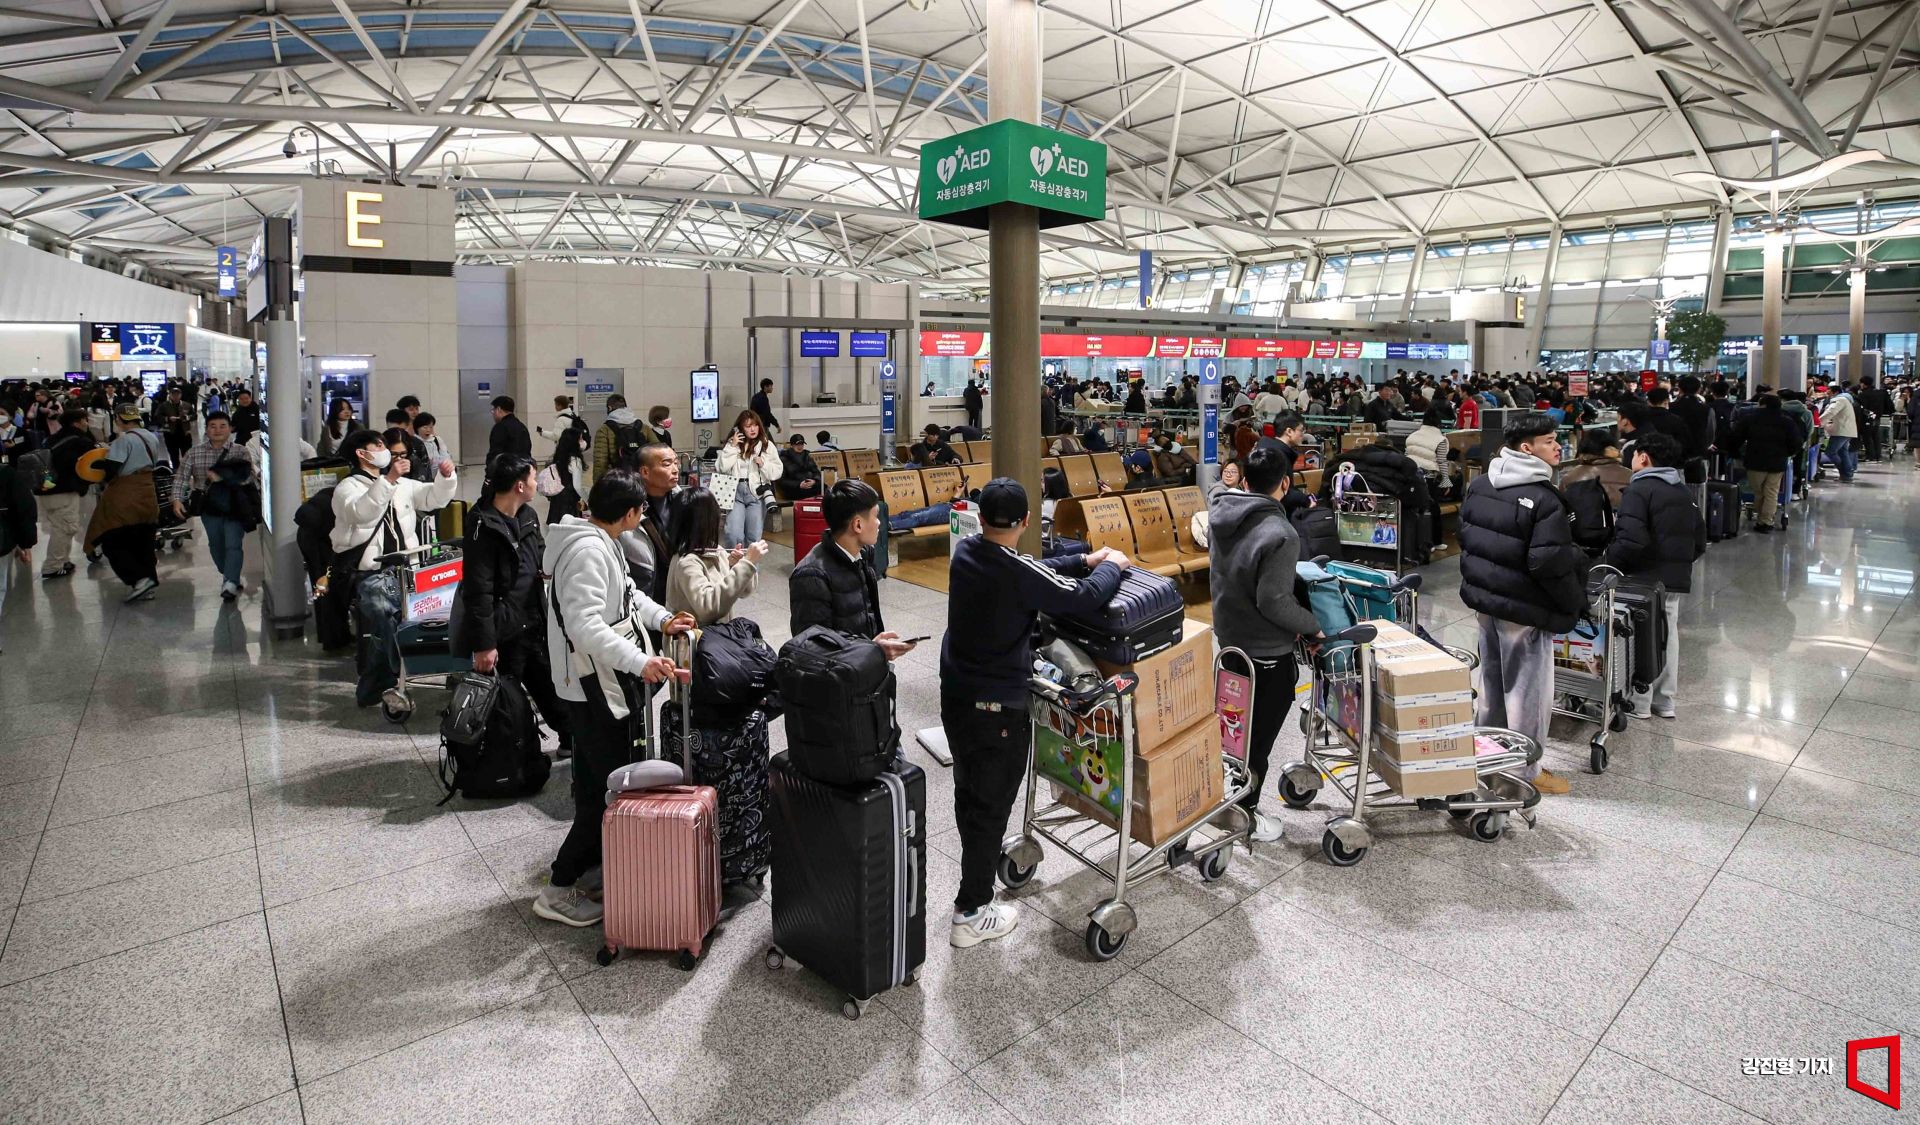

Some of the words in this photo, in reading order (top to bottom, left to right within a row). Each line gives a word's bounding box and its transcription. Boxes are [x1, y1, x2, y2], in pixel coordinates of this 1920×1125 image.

[960, 148, 991, 173] AED
[1056, 155, 1089, 178] AED
[936, 178, 990, 201] 자동심장충격기
[1029, 178, 1088, 203] 자동심장충격기
[346, 191, 384, 248] E
[222, 253, 233, 266] 2
[1516, 296, 1525, 320] E
[101, 328, 112, 339] 2
